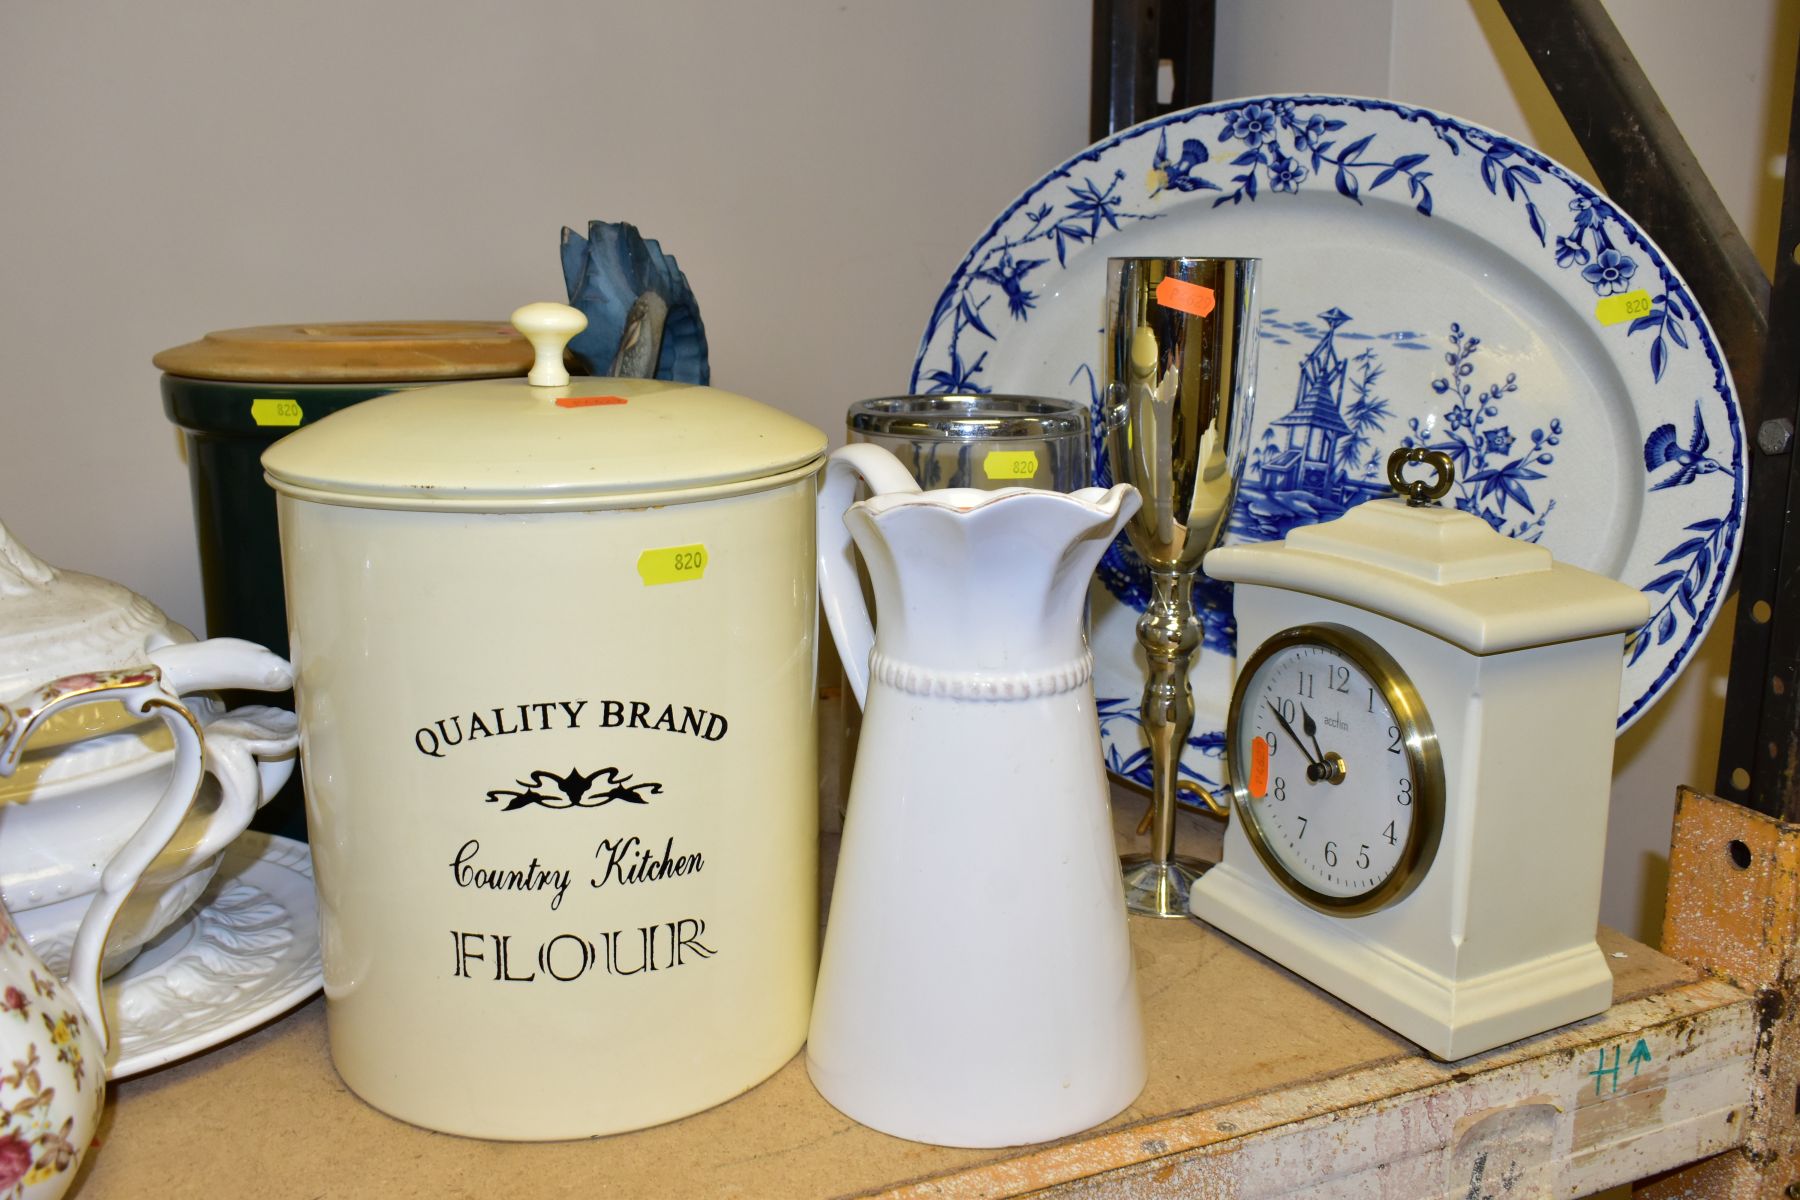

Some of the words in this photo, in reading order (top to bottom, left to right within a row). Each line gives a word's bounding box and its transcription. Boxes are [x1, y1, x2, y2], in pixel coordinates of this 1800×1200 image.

[1625, 297, 1649, 314] 820
[277, 403, 298, 417] 820
[1013, 461, 1034, 474] 820
[674, 551, 702, 571] 820
[1297, 671, 1314, 699] 11
[1327, 664, 1350, 694] 12
[1276, 696, 1295, 725] 10
[1367, 687, 1374, 714] 1
[414, 700, 588, 758] QUALITY
[598, 700, 728, 742] BRAND
[1387, 725, 1401, 755] 2
[1265, 731, 1278, 756] 9
[1274, 776, 1286, 802] 8
[1397, 778, 1412, 806] 3
[1297, 816, 1308, 840] 7
[1382, 820, 1397, 846] 4
[1324, 841, 1337, 867] 6
[1356, 844, 1370, 869] 5
[449, 839, 571, 911] Country
[590, 836, 705, 889] Kitchen
[450, 918, 718, 982] FLOUR
[1589, 1043, 1621, 1096] H
